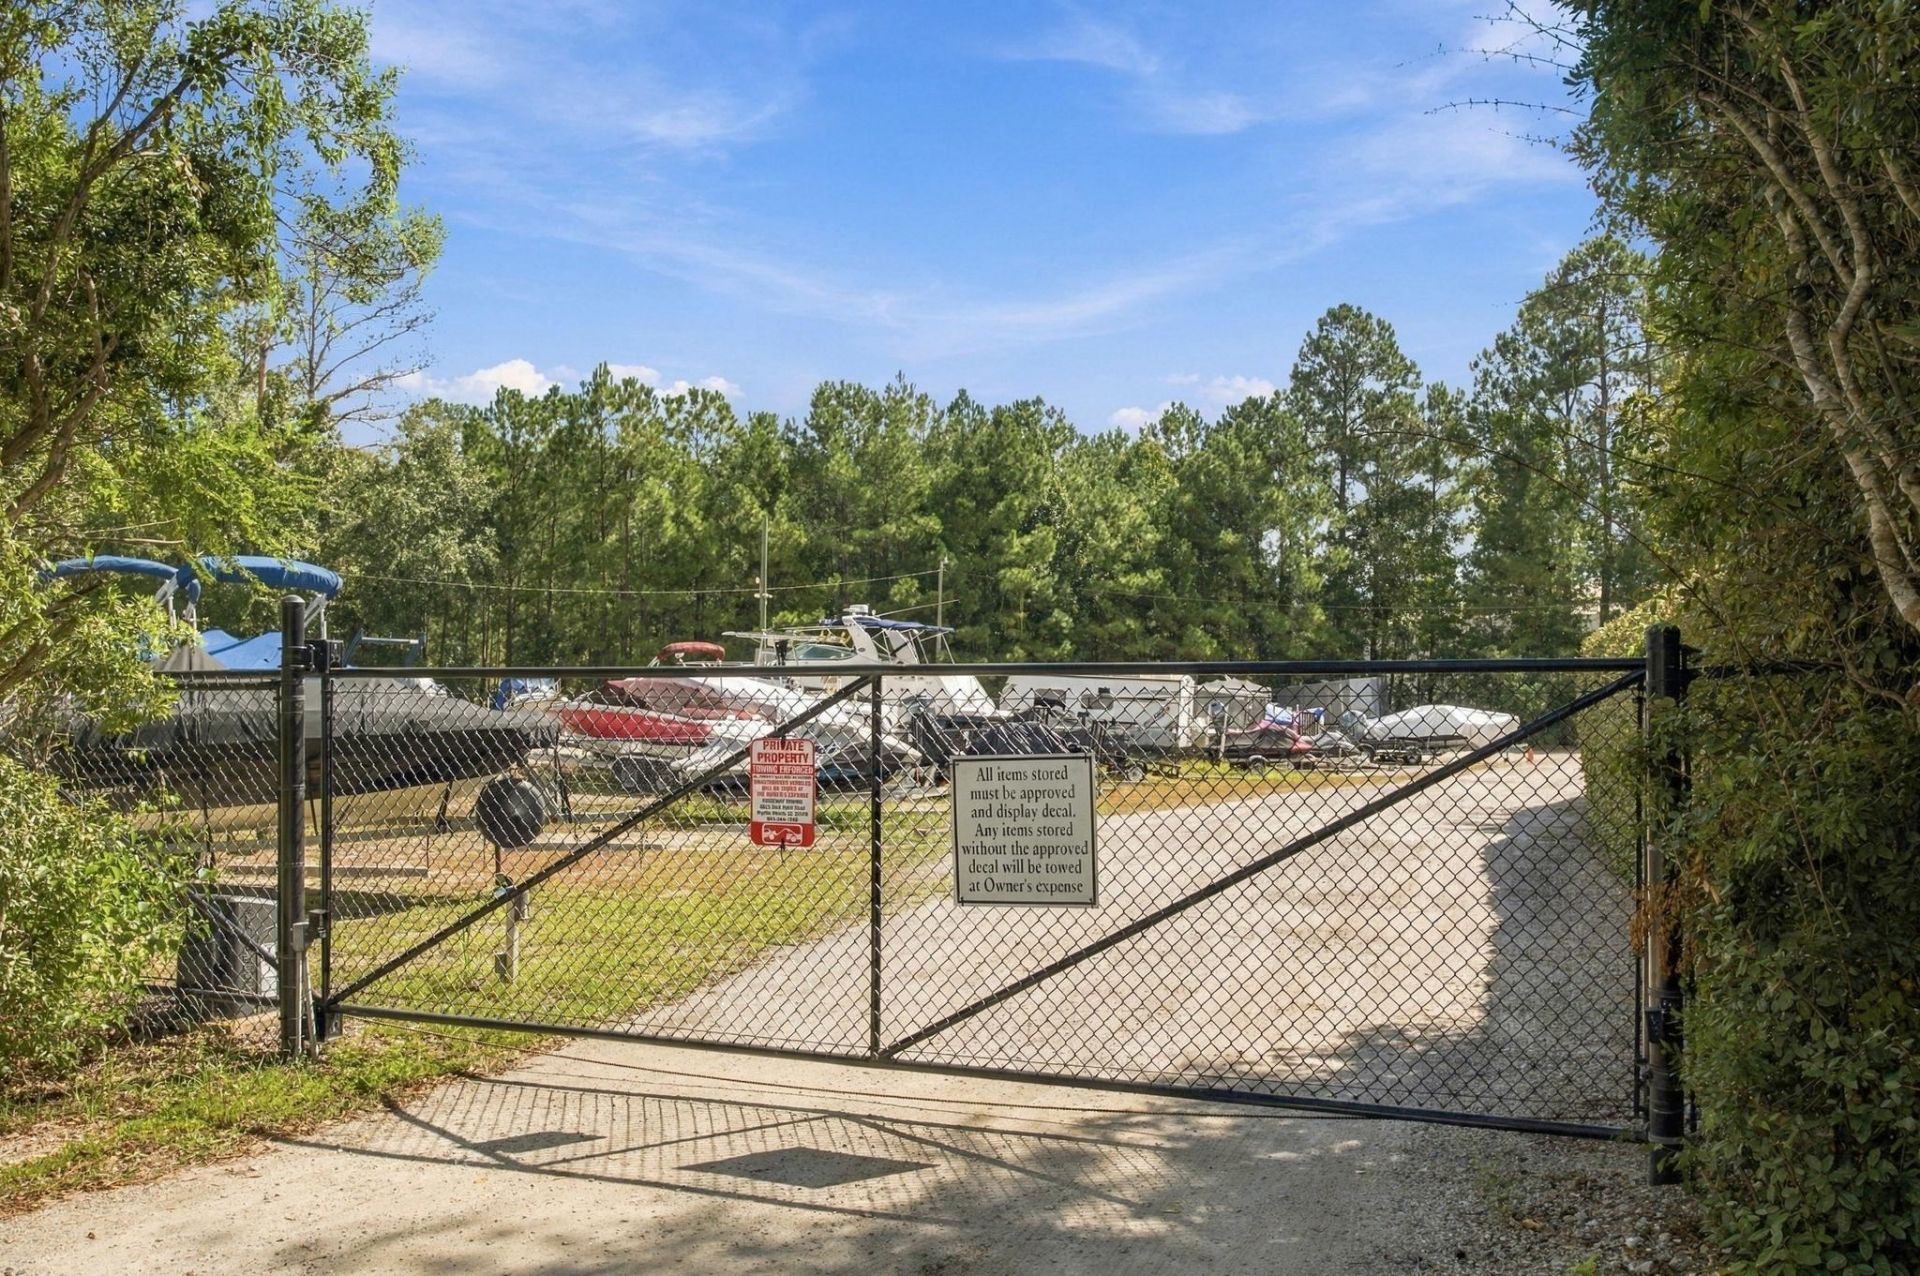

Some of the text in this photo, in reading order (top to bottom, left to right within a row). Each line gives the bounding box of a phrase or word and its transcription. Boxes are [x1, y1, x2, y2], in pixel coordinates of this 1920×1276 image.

[763, 741, 804, 751] PRIVATE
[757, 752, 809, 763] PROPERTY
[753, 765, 813, 774] TOWING ENFORCED
[976, 765, 1068, 781] All items stored
[970, 784, 1075, 803] must be approved
[971, 803, 1076, 822] and display decal.
[975, 822, 1073, 840] Any items stored
[962, 841, 1088, 859] without the approved
[969, 859, 1082, 874] decal will be towed
[969, 877, 1083, 896] at Owner's expense
